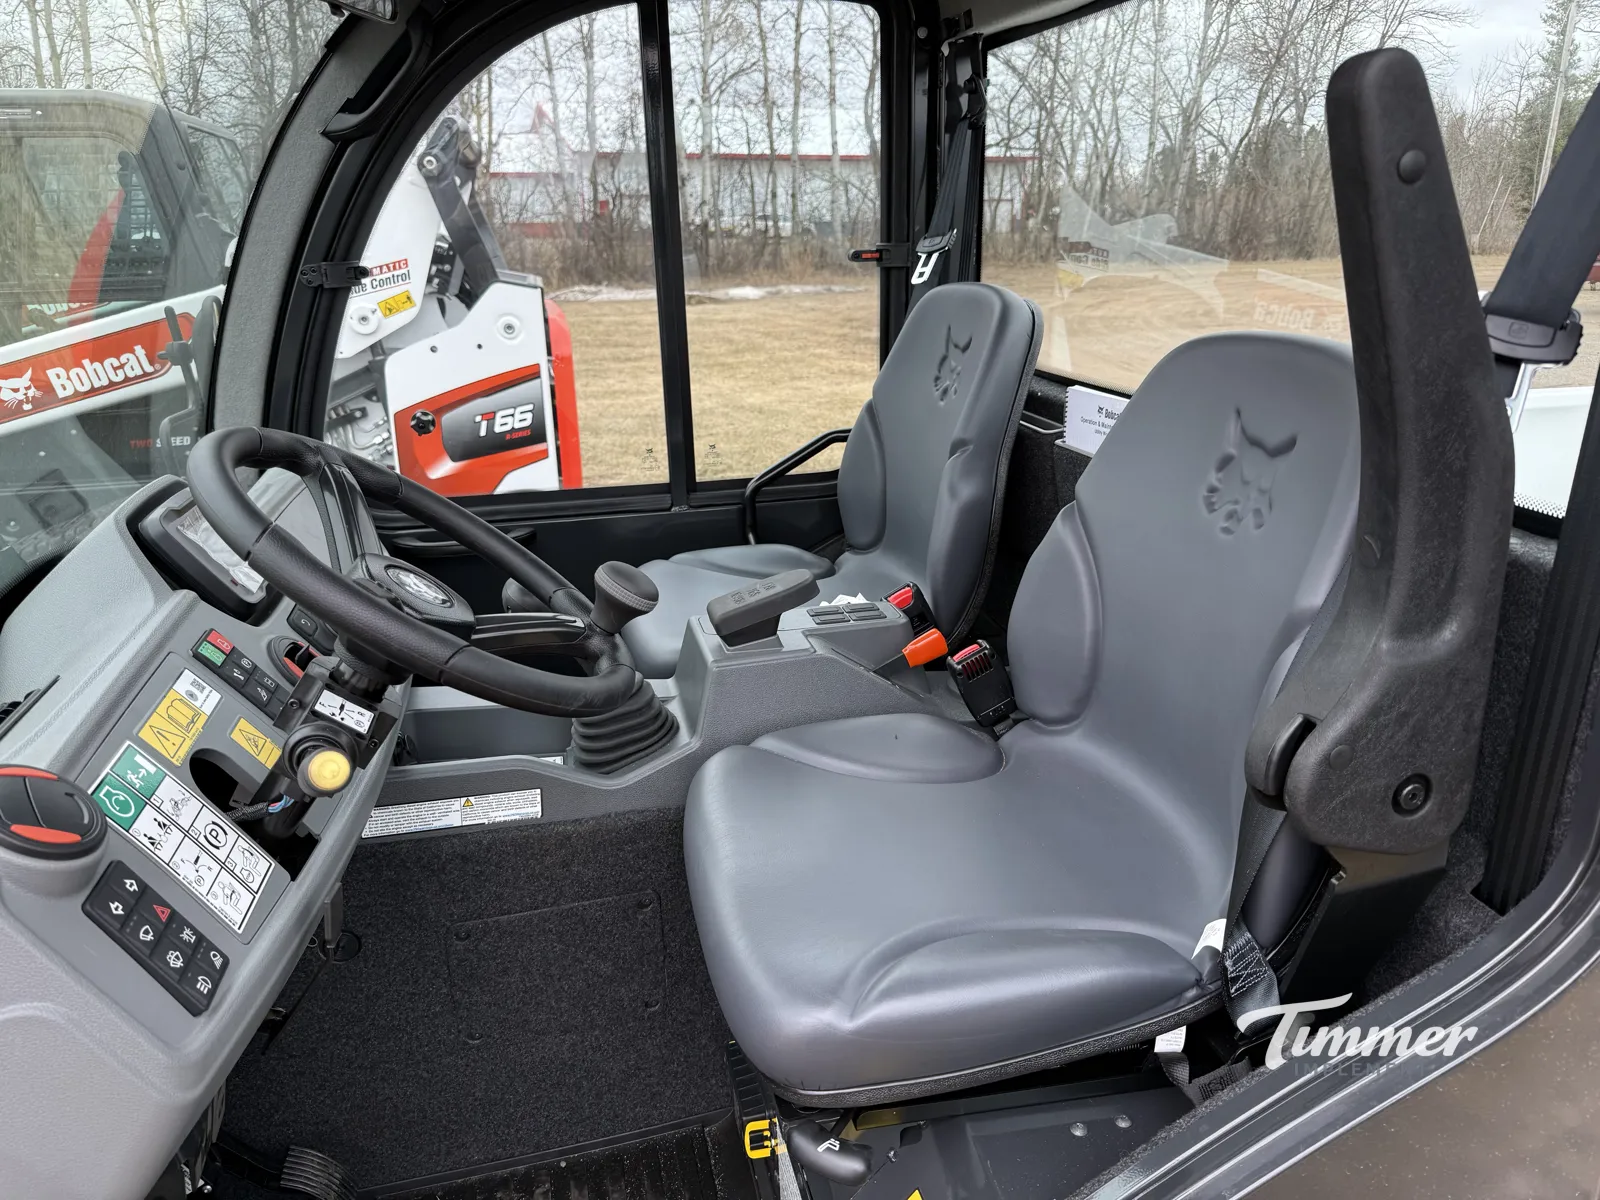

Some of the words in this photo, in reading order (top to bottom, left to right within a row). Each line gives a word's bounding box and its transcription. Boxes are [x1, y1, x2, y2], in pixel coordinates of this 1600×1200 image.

[371, 270, 411, 290] Control
[46, 345, 154, 399] Bobcat
[474, 403, 535, 437] T66
[156, 435, 191, 448] SEED
[209, 828, 222, 844] P
